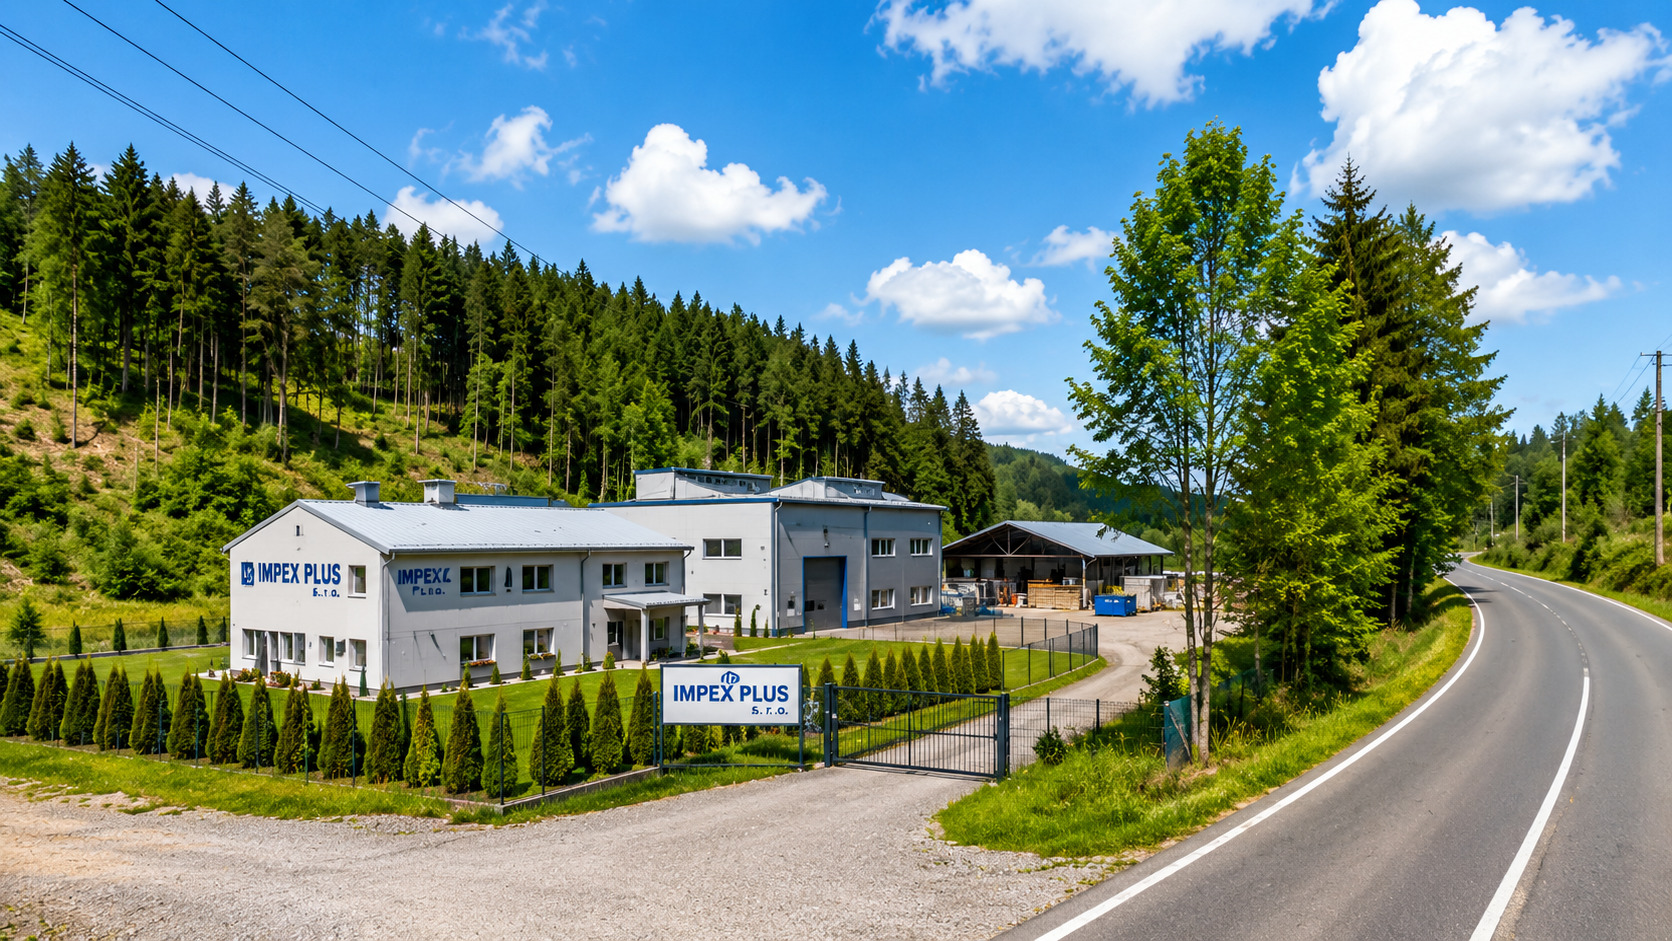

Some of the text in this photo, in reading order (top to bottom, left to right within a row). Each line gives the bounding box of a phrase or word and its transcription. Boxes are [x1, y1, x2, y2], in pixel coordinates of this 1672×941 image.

[258, 563, 300, 584] IMPEX
[304, 563, 341, 585] PLUS
[673, 685, 789, 702] IMPEX PLUS
